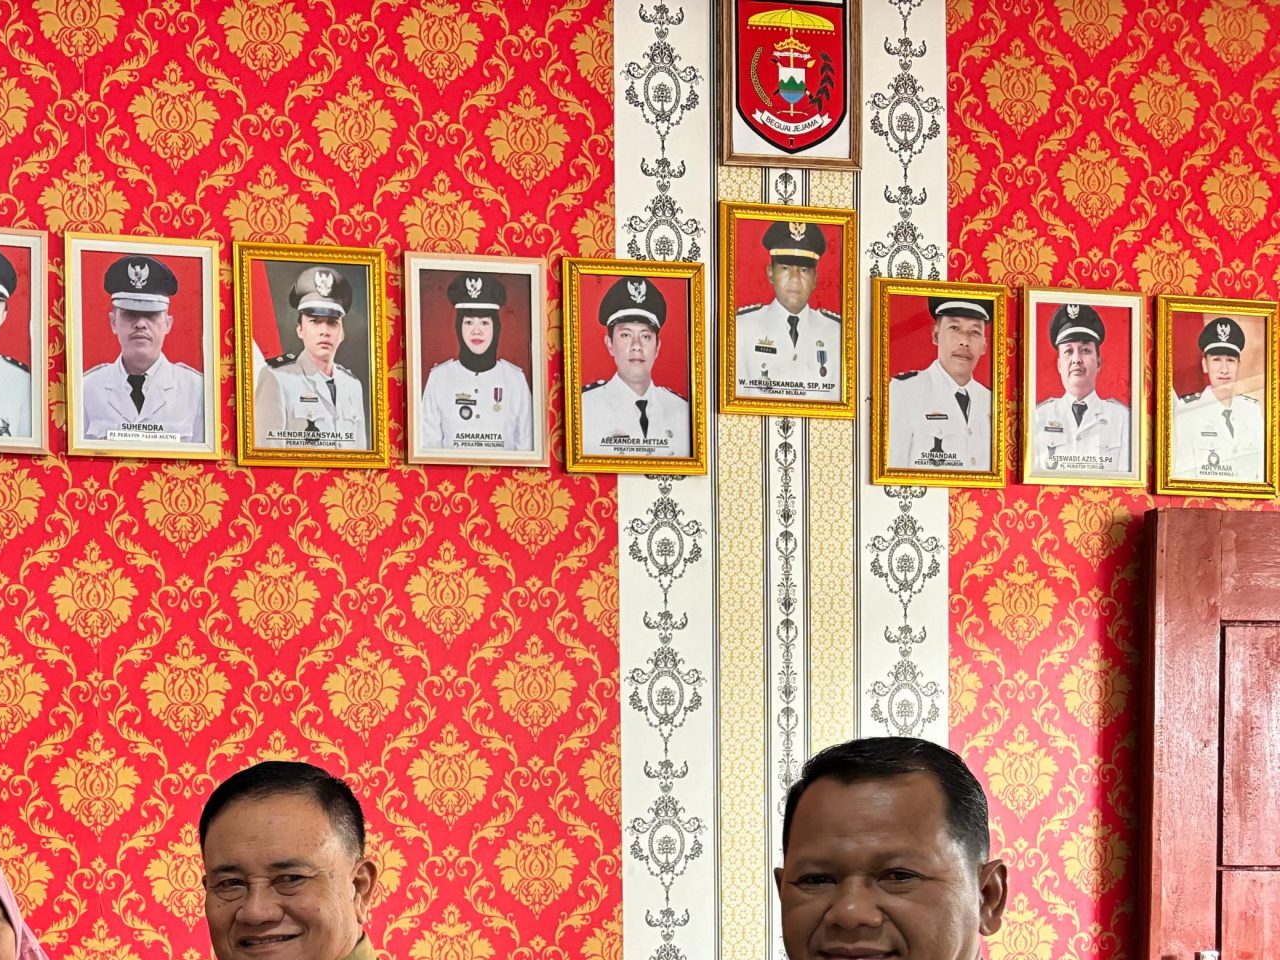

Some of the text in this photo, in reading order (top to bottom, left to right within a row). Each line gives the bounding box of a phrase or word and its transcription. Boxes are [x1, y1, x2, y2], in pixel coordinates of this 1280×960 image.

[765, 115, 819, 132] BEGUAI JEJAMA
[121, 423, 164, 431] SUHENDRA
[643, 438, 668, 446] METIAS
